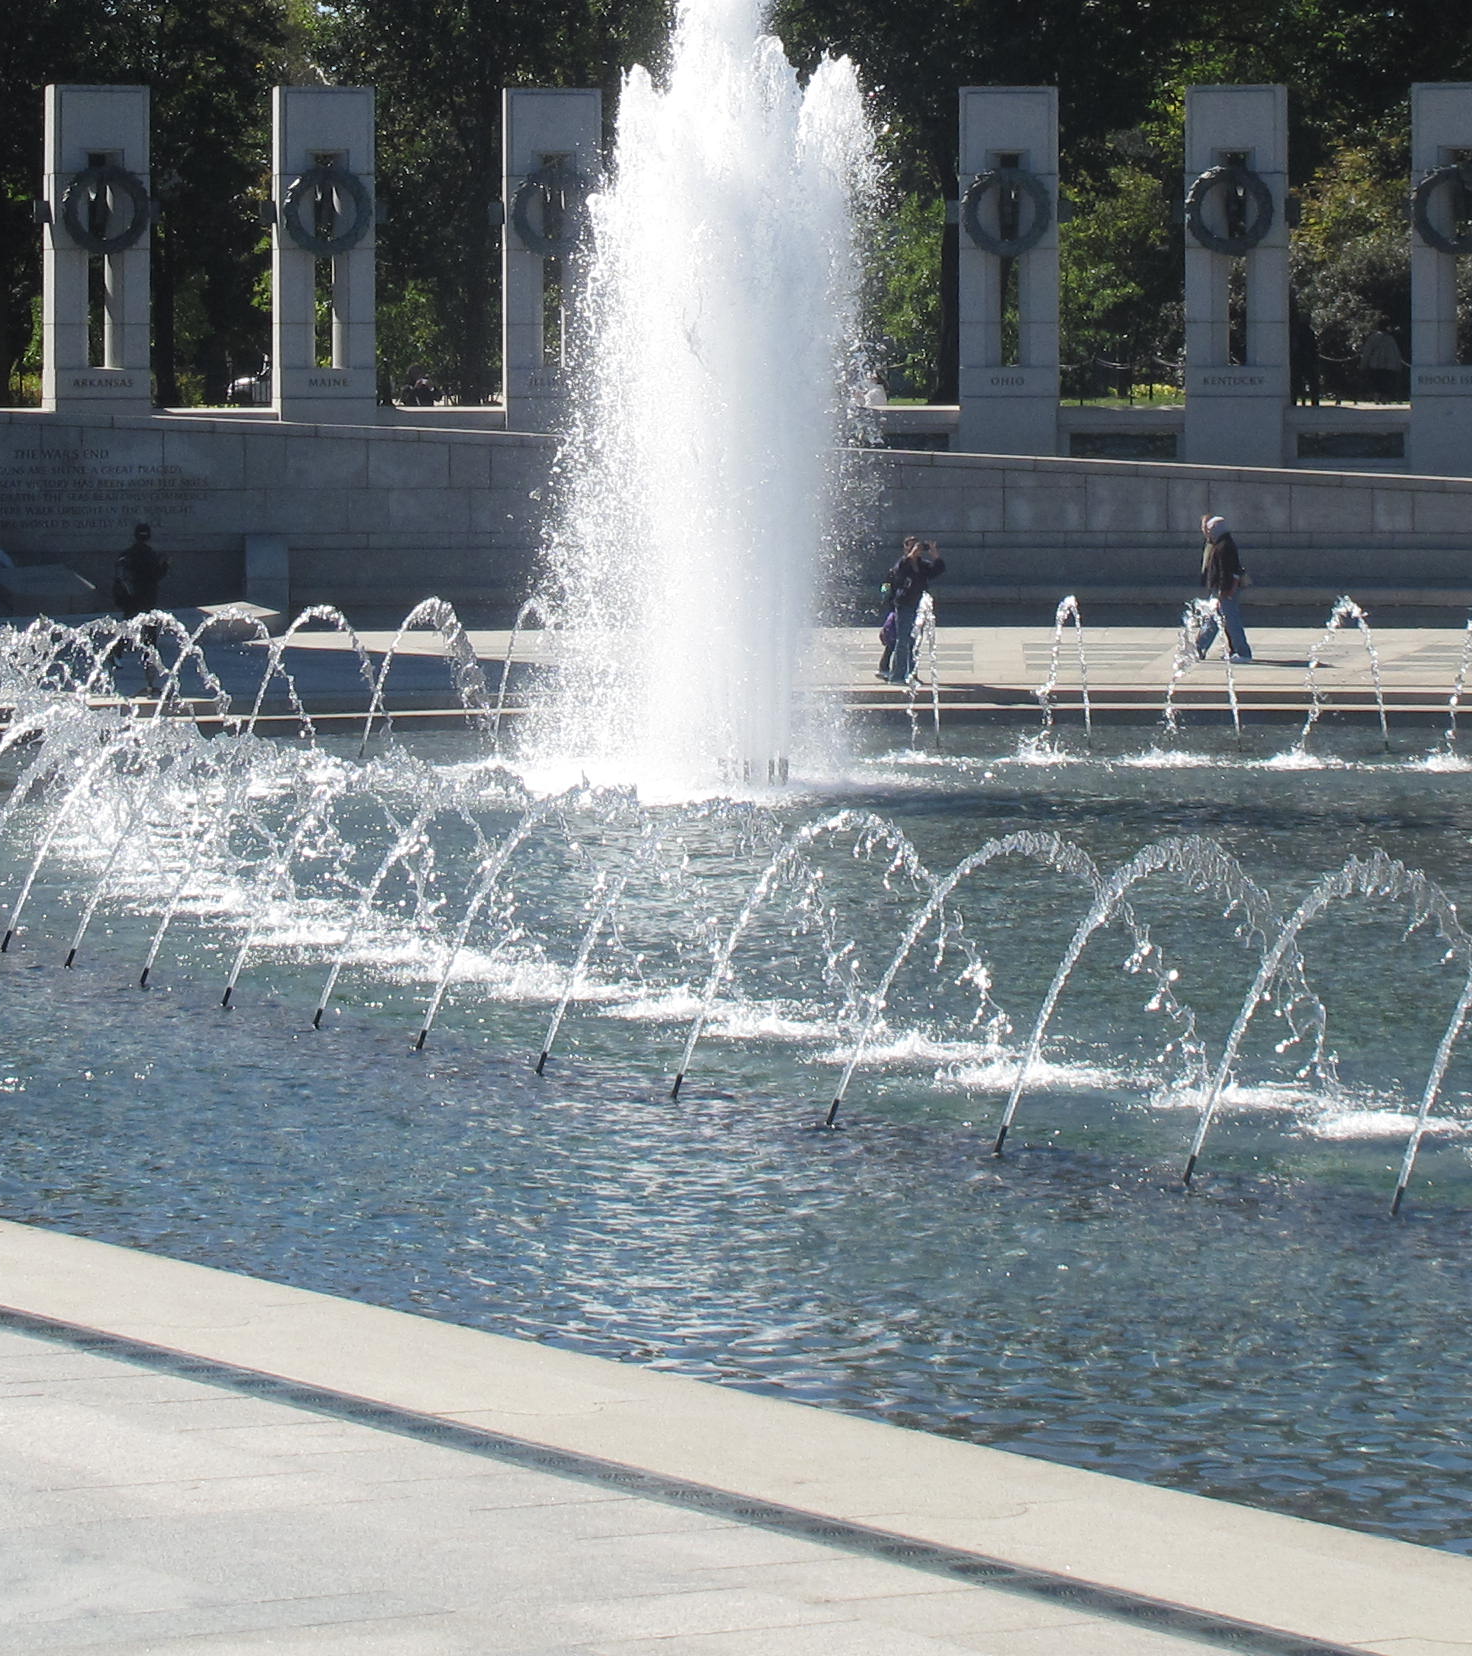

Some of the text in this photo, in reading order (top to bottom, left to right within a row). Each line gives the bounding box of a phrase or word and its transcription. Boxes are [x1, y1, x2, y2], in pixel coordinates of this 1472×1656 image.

[73, 378, 134, 387] ARKANSAS
[309, 377, 350, 387] MAINE
[990, 376, 1025, 386] OHIO
[1203, 376, 1264, 386] KENTUCKY
[1417, 375, 1457, 386] RHODE
[14, 449, 38, 460] THE
